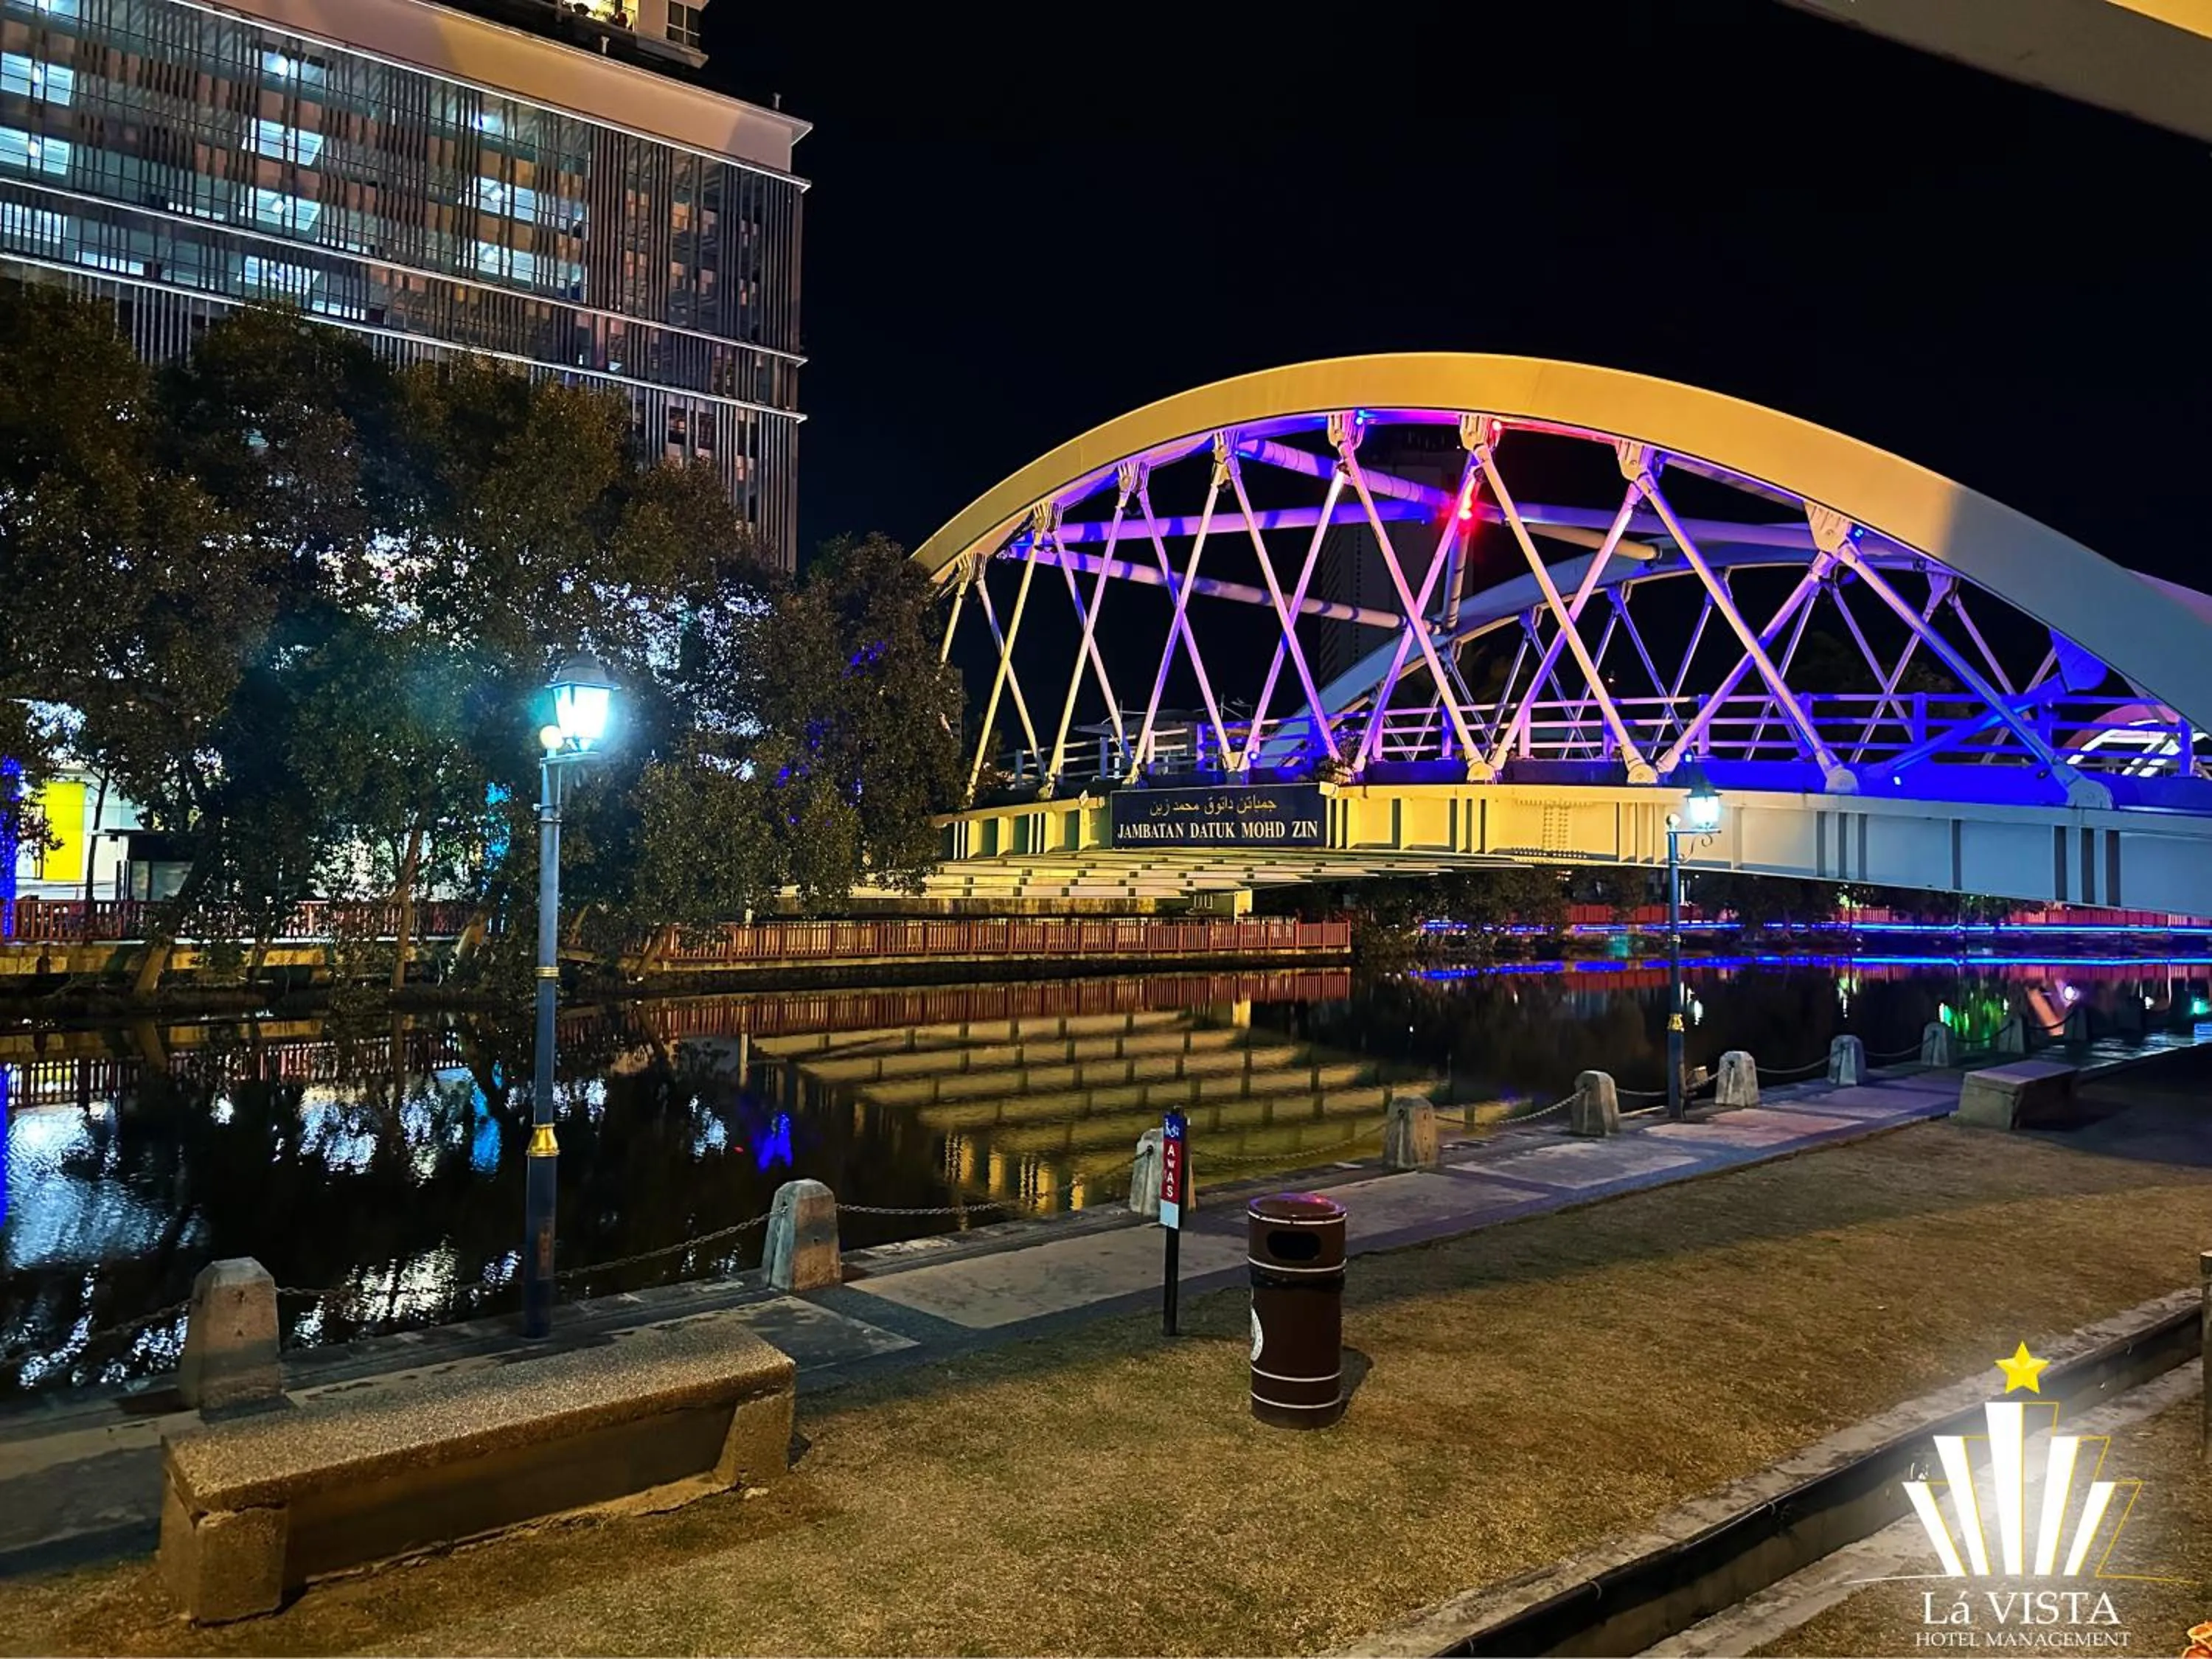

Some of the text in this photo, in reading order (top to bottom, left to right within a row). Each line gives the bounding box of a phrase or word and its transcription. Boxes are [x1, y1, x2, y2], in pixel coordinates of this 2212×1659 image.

[1150, 799, 1170, 816] زين
[1173, 801, 1200, 811] محمد
[1117, 821, 1318, 838] JAMBATAN DATUK MOHD ZIN
[1167, 1144, 1175, 1197] AWAS
